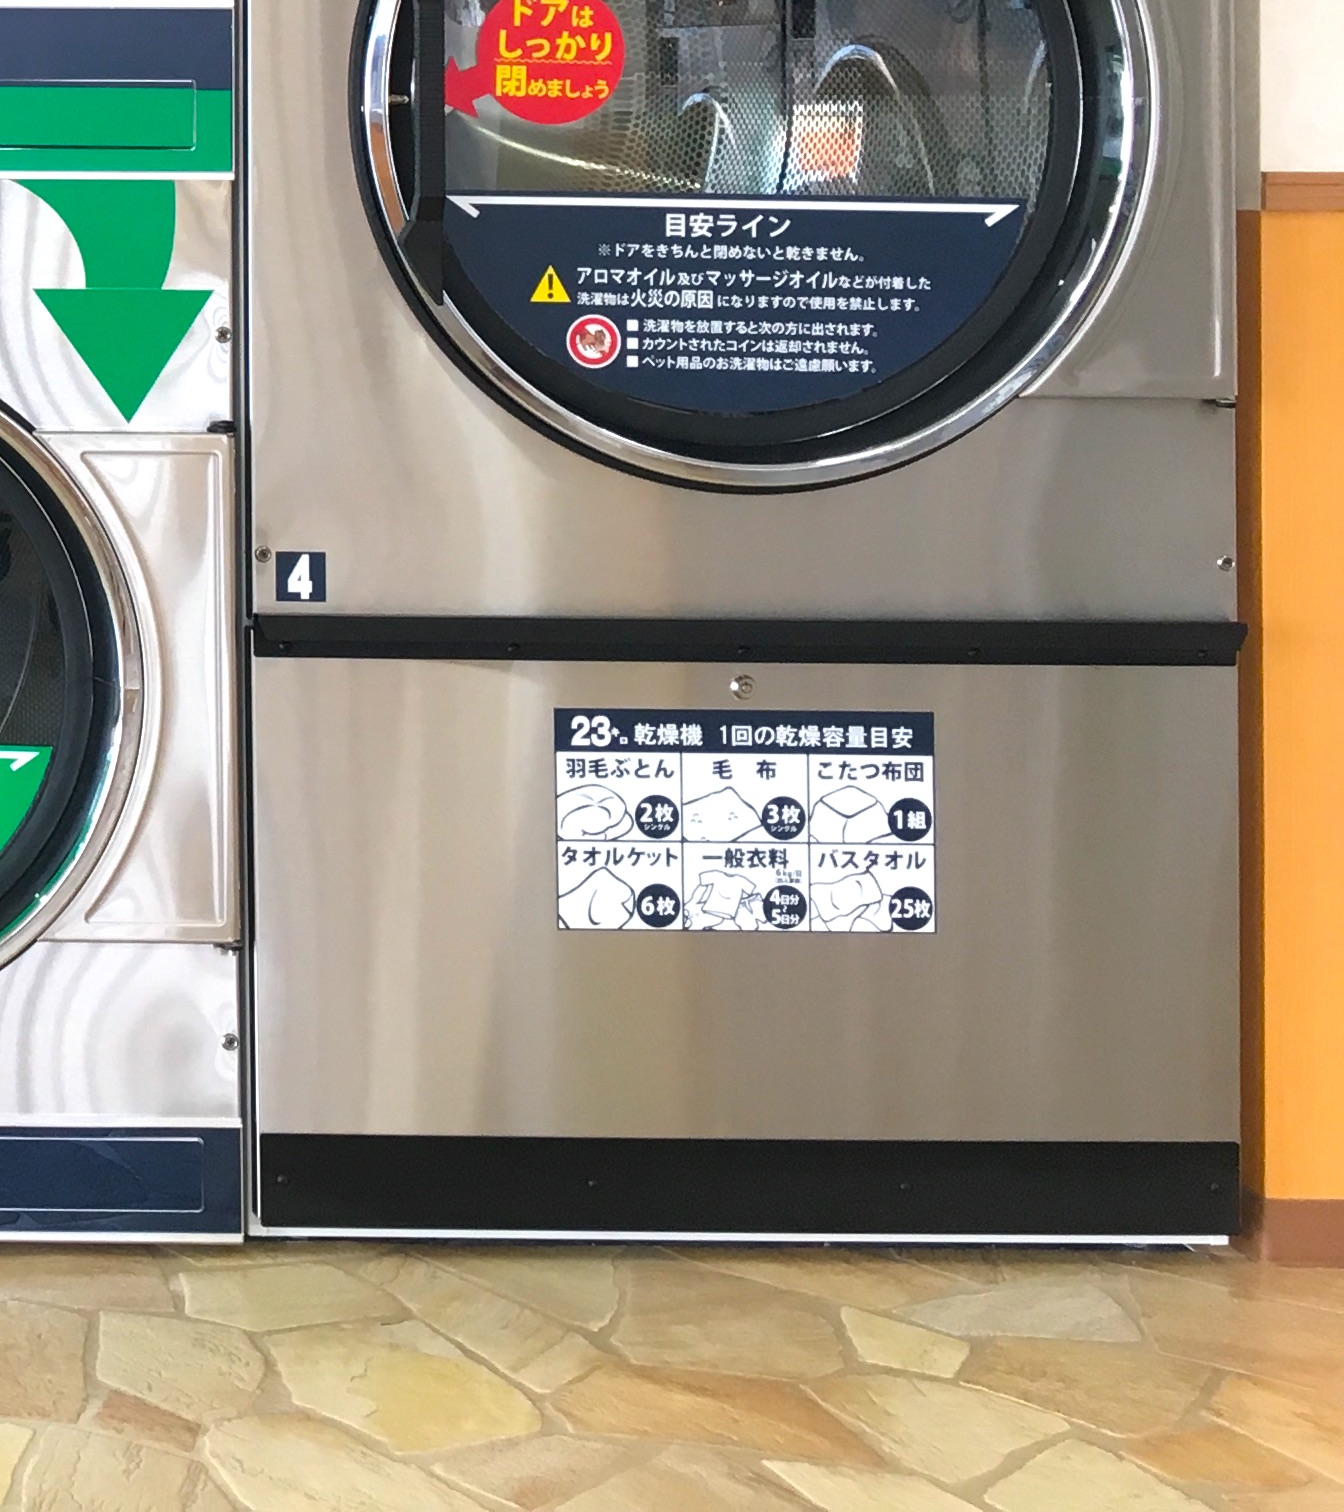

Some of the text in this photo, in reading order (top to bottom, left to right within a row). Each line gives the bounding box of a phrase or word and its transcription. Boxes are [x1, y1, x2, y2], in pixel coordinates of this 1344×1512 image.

[498, 31, 612, 60] しっかり
[496, 65, 610, 98] 閉めましょう
[664, 213, 792, 238] 目安ライン
[576, 266, 932, 292] アロマオイル及びマッサージオイルなどが付着した
[643, 319, 880, 336] 洗濯物を放置すると次の方に出されます。
[642, 336, 870, 355] カウントされたコインは返却されません。
[642, 354, 879, 373] ペット用品のお洗濯物はご遠慮願います。
[288, 554, 312, 599] 4
[719, 724, 913, 749] 1回の乾燥容量目安
[566, 759, 674, 778] 羽毛ぶとん
[818, 761, 924, 782] こたつ布団
[640, 803, 674, 823] 2枚
[767, 804, 801, 824] 3枚
[893, 811, 926, 830] 1組
[644, 823, 670, 831] シングル
[561, 847, 678, 867] タオルケット
[702, 848, 789, 868] 一般衣料
[818, 851, 926, 870] バスタオル
[641, 896, 675, 916] 6枚
[770, 893, 799, 906] 4日分
[891, 899, 931, 919] 25枚
[771, 911, 799, 925] 5日分
